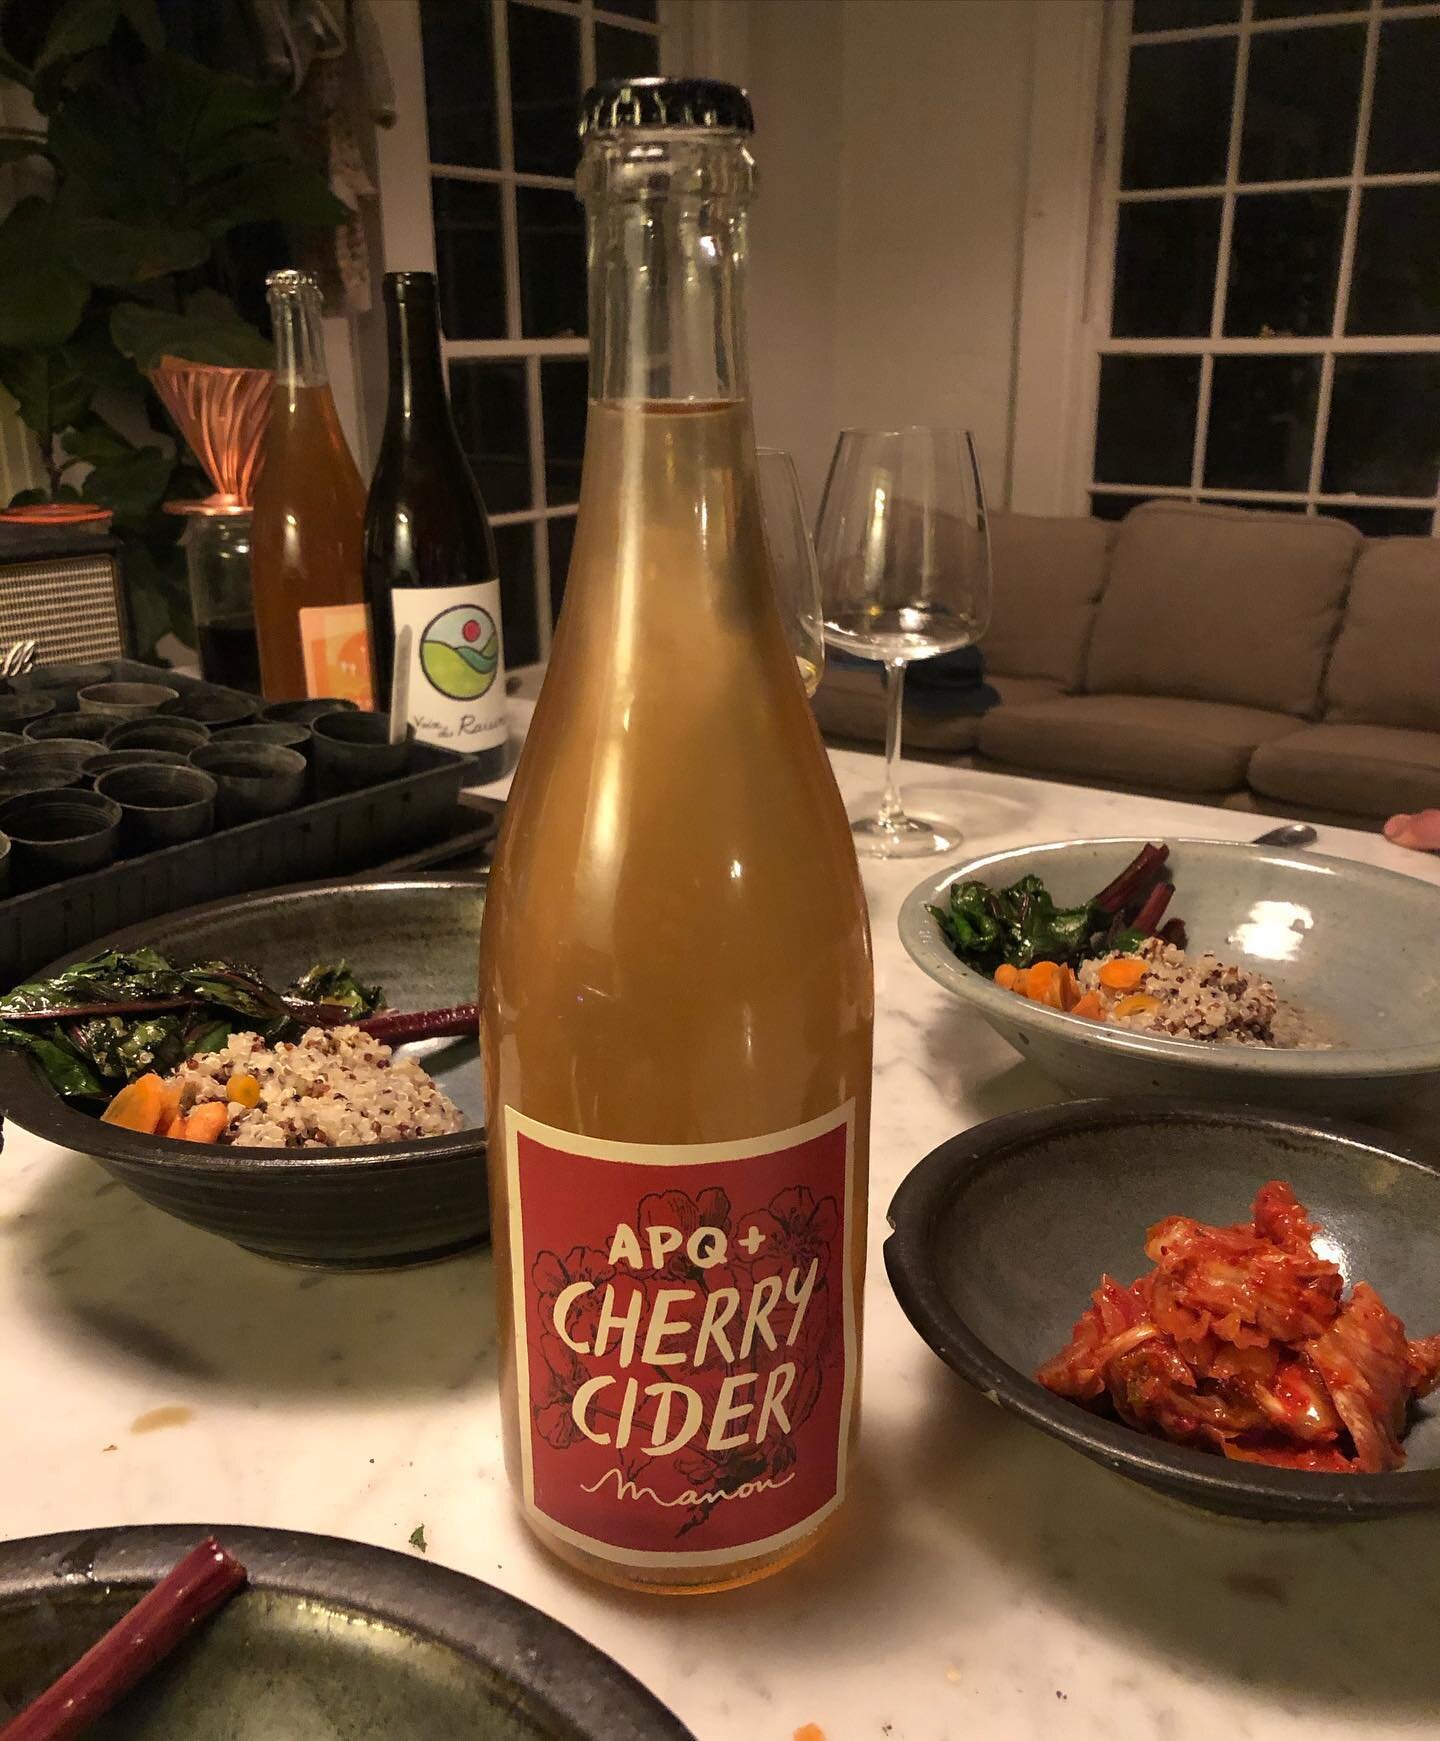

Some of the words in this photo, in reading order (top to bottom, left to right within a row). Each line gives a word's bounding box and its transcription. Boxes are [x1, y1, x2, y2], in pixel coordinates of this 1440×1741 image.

[553, 1258, 818, 1367] CHERRY
[572, 1362, 796, 1456] CIDER
[580, 1468, 795, 1506] Manon
